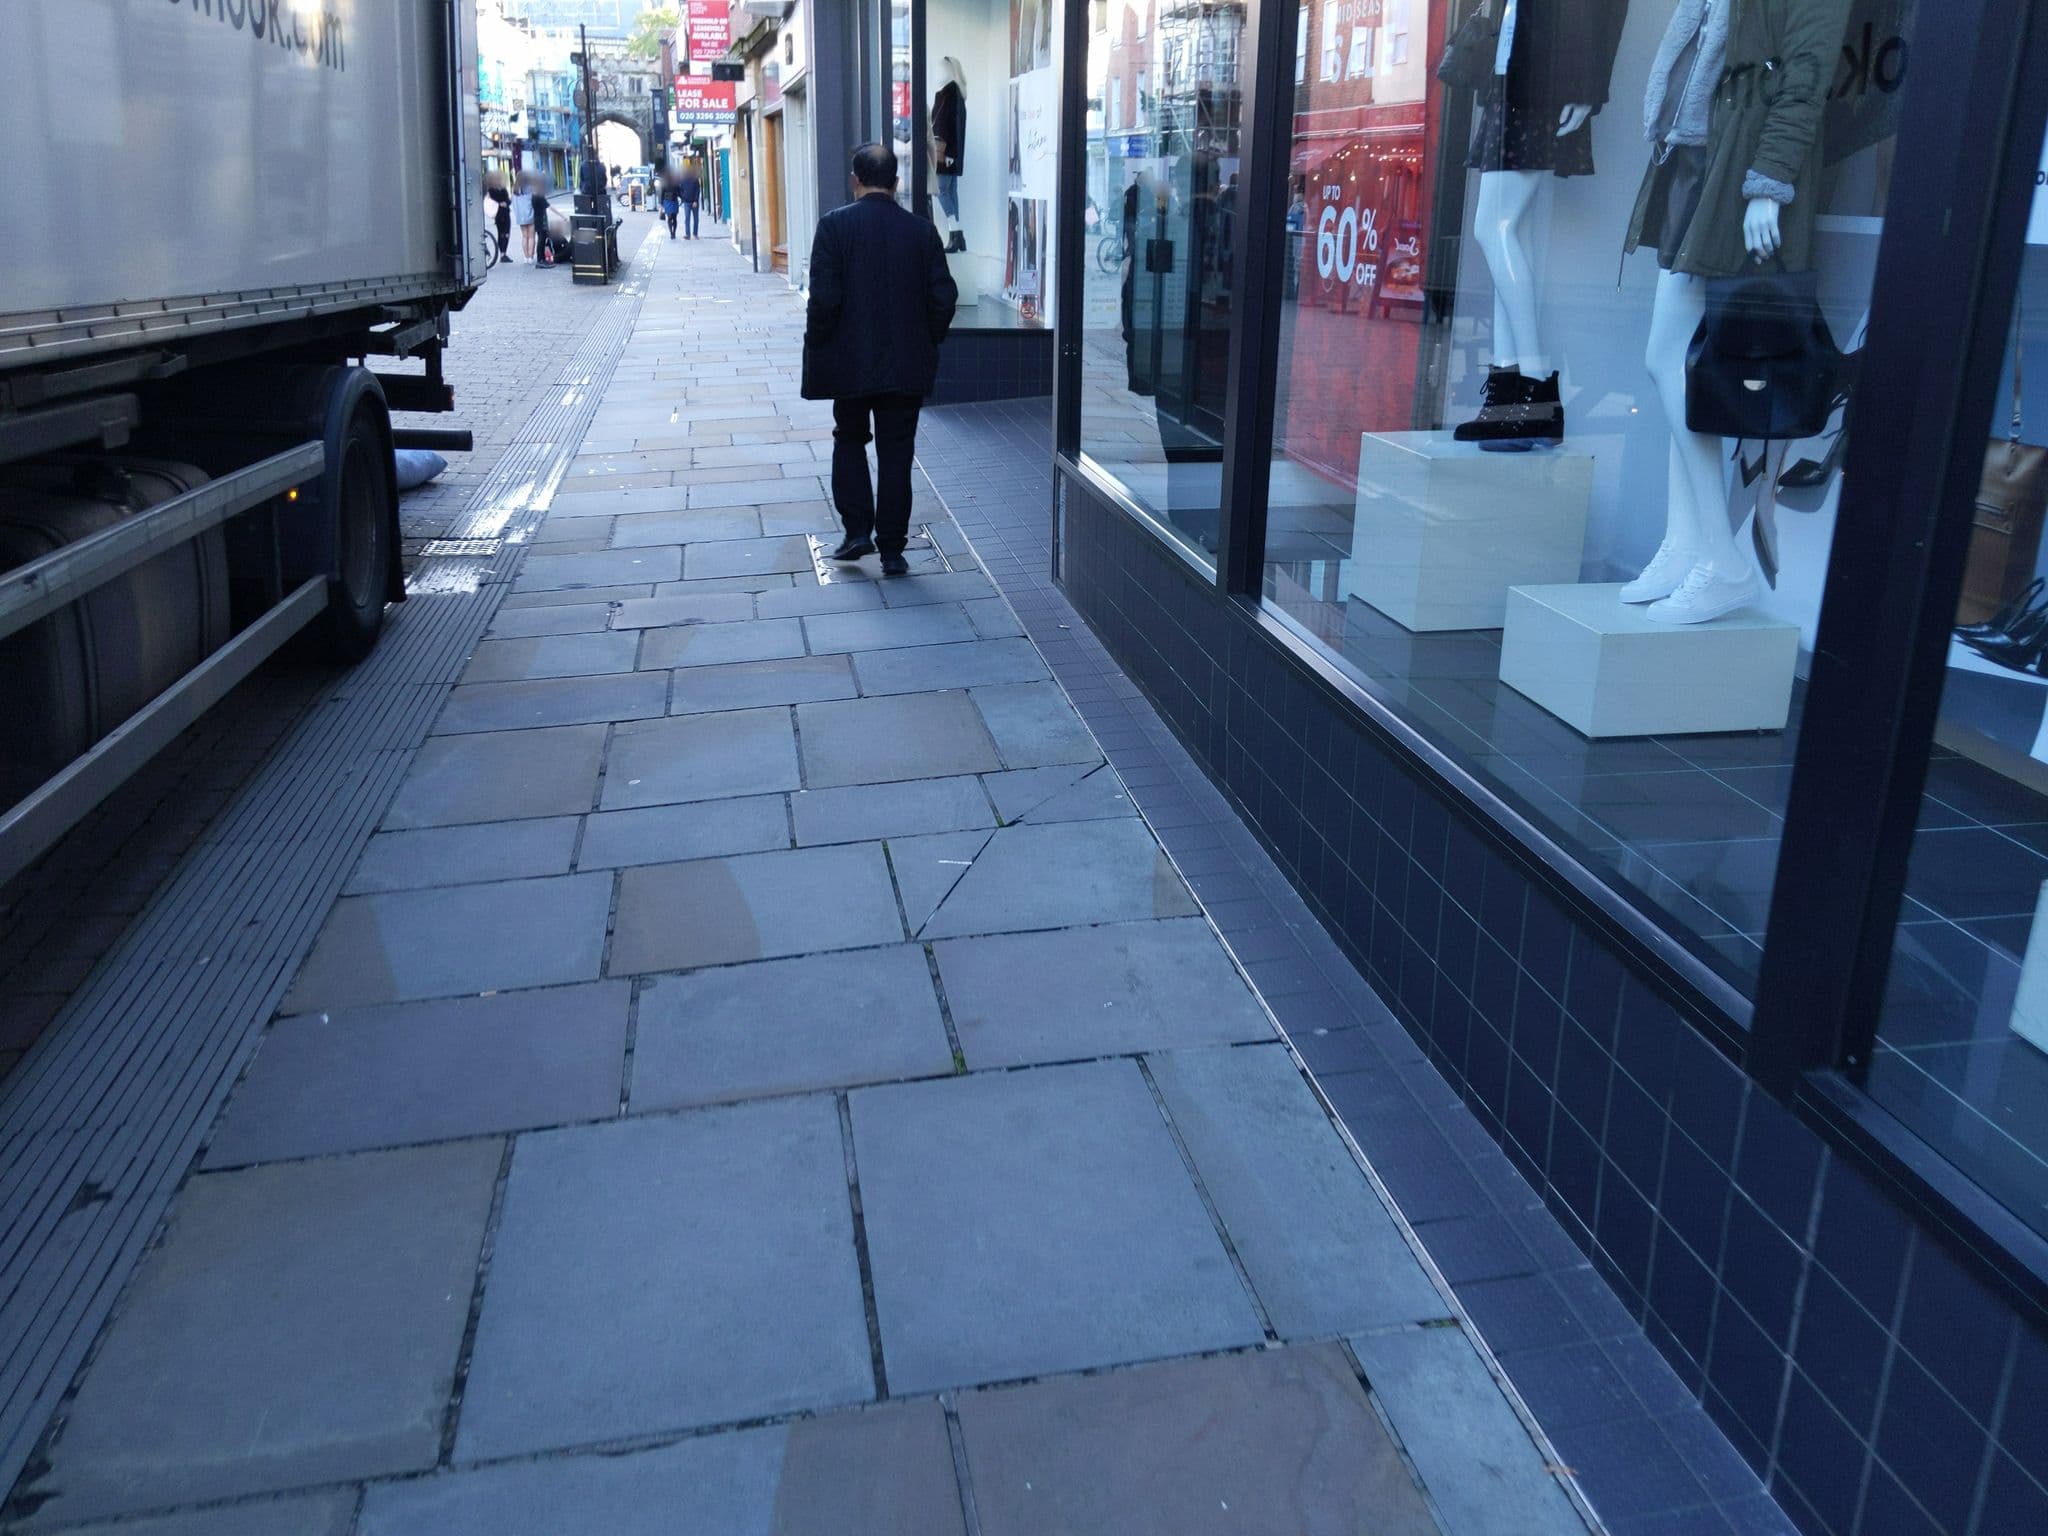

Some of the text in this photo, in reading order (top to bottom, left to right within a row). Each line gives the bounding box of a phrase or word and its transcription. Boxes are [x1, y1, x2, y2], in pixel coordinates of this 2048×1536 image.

[692, 32, 728, 40] AVAILABLE
[677, 89, 702, 97] LEASE
[679, 98, 728, 108] FOR SALE
[680, 112, 695, 120] 020
[715, 112, 735, 120] 2000
[1323, 185, 1341, 200] UP TO
[1355, 263, 1377, 288] OFF
